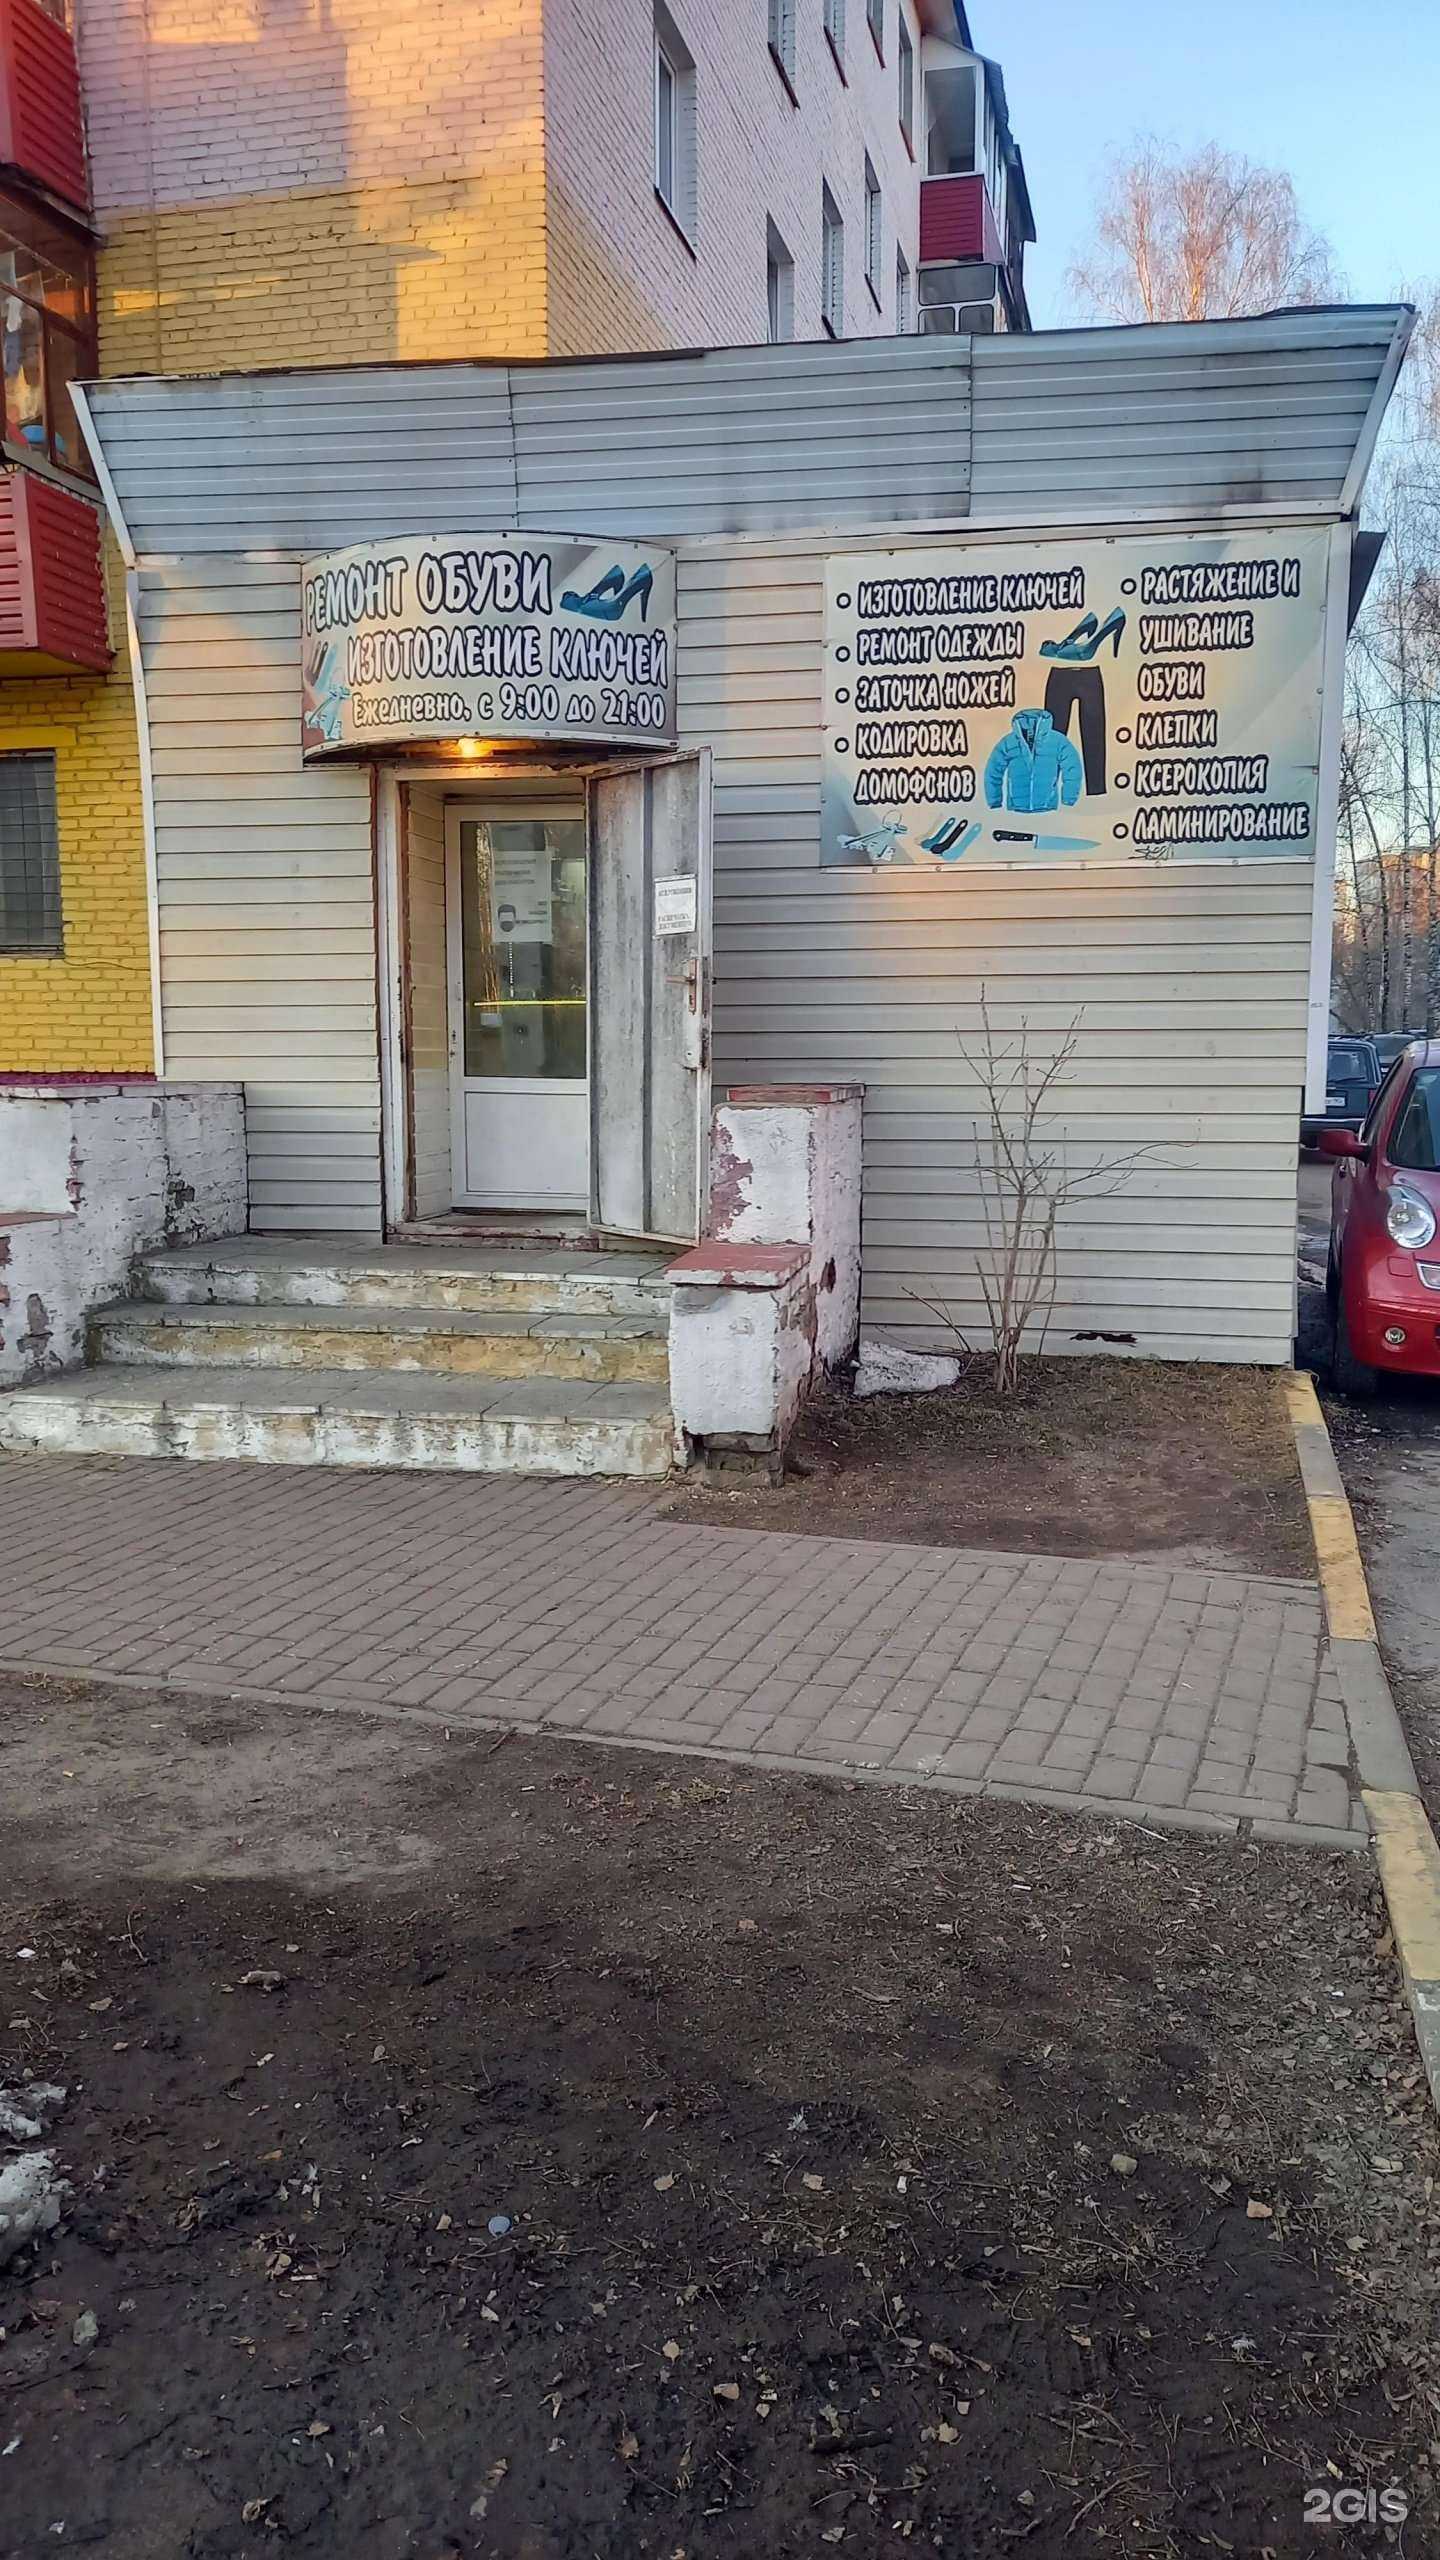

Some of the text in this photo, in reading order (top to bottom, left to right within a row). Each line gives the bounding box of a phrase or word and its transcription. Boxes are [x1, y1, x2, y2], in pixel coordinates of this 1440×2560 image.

[305, 550, 552, 636] РЕМОНТ ОБУВИ
[858, 566, 1084, 618] ИЗГОТОВЛЕНИЕ КЛЮЧЕЙ
[1141, 559, 1300, 604] РАСТЯЖЕНИЕ И
[857, 621, 1025, 665] РЕМОНТ ОДЕЖДЫ
[1139, 611, 1253, 654] УШИВАНИЕ
[347, 625, 668, 688] ИЗГОТОВЛЕНИЕ КЛЮЧЕЙ
[856, 665, 1015, 712] ЗАТОЧКА НОЖЕЙ
[1138, 661, 1204, 701] ОБУВИ
[351, 684, 665, 729] Ежедневно, с 9:00 до 21:00
[855, 720, 968, 759] КОДИРОВКА
[1135, 710, 1217, 749] КЛЕПКИ
[853, 766, 976, 805] ДОМОФОНОВ
[1134, 754, 1269, 797] КСЕРОКОПИЯ
[1132, 802, 1310, 844] ЛАМИНИРОВАНИЕ
